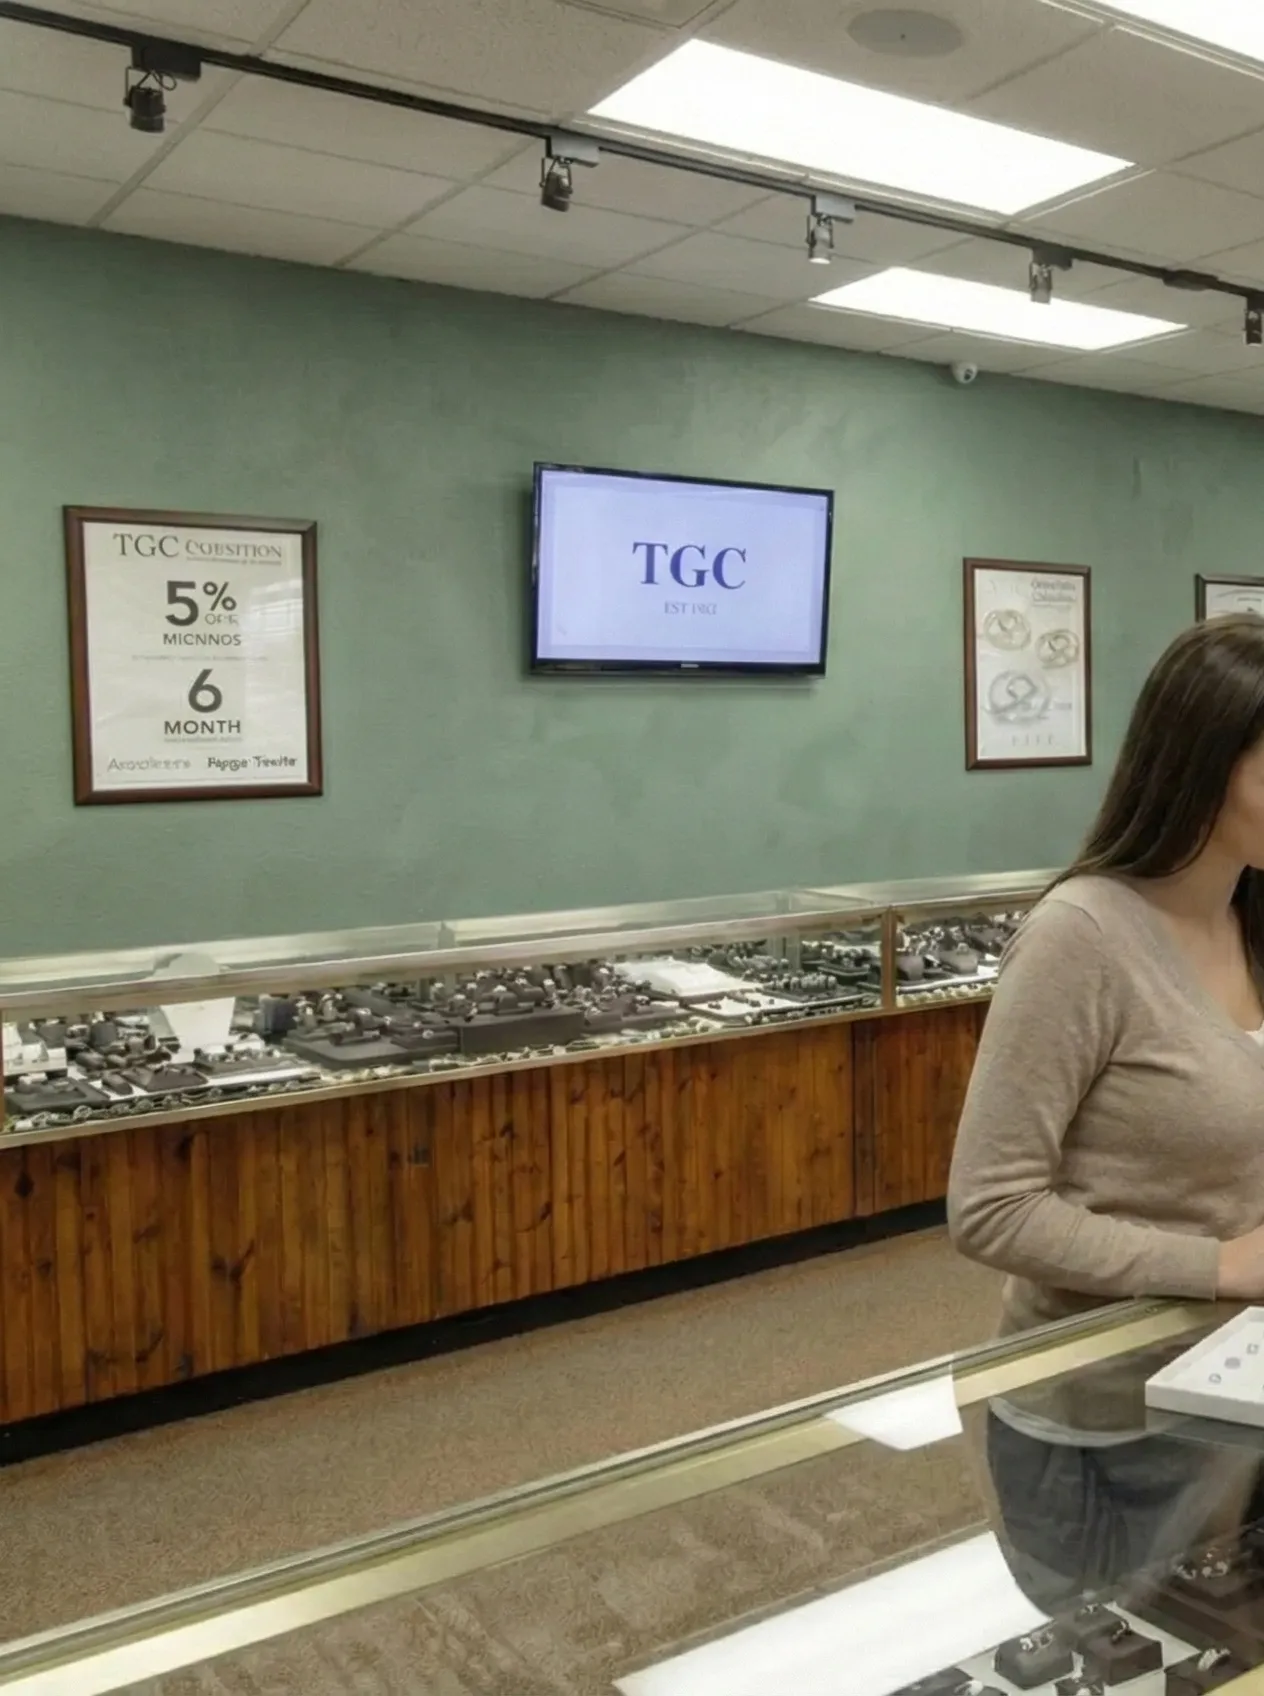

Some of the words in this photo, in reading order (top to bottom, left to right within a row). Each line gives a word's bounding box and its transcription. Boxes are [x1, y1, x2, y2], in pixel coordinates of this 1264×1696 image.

[113, 532, 179, 558] TGC
[632, 541, 747, 590] TGC
[165, 580, 237, 627] 5%
[188, 668, 223, 713] 6
[164, 720, 242, 735] MONTH
